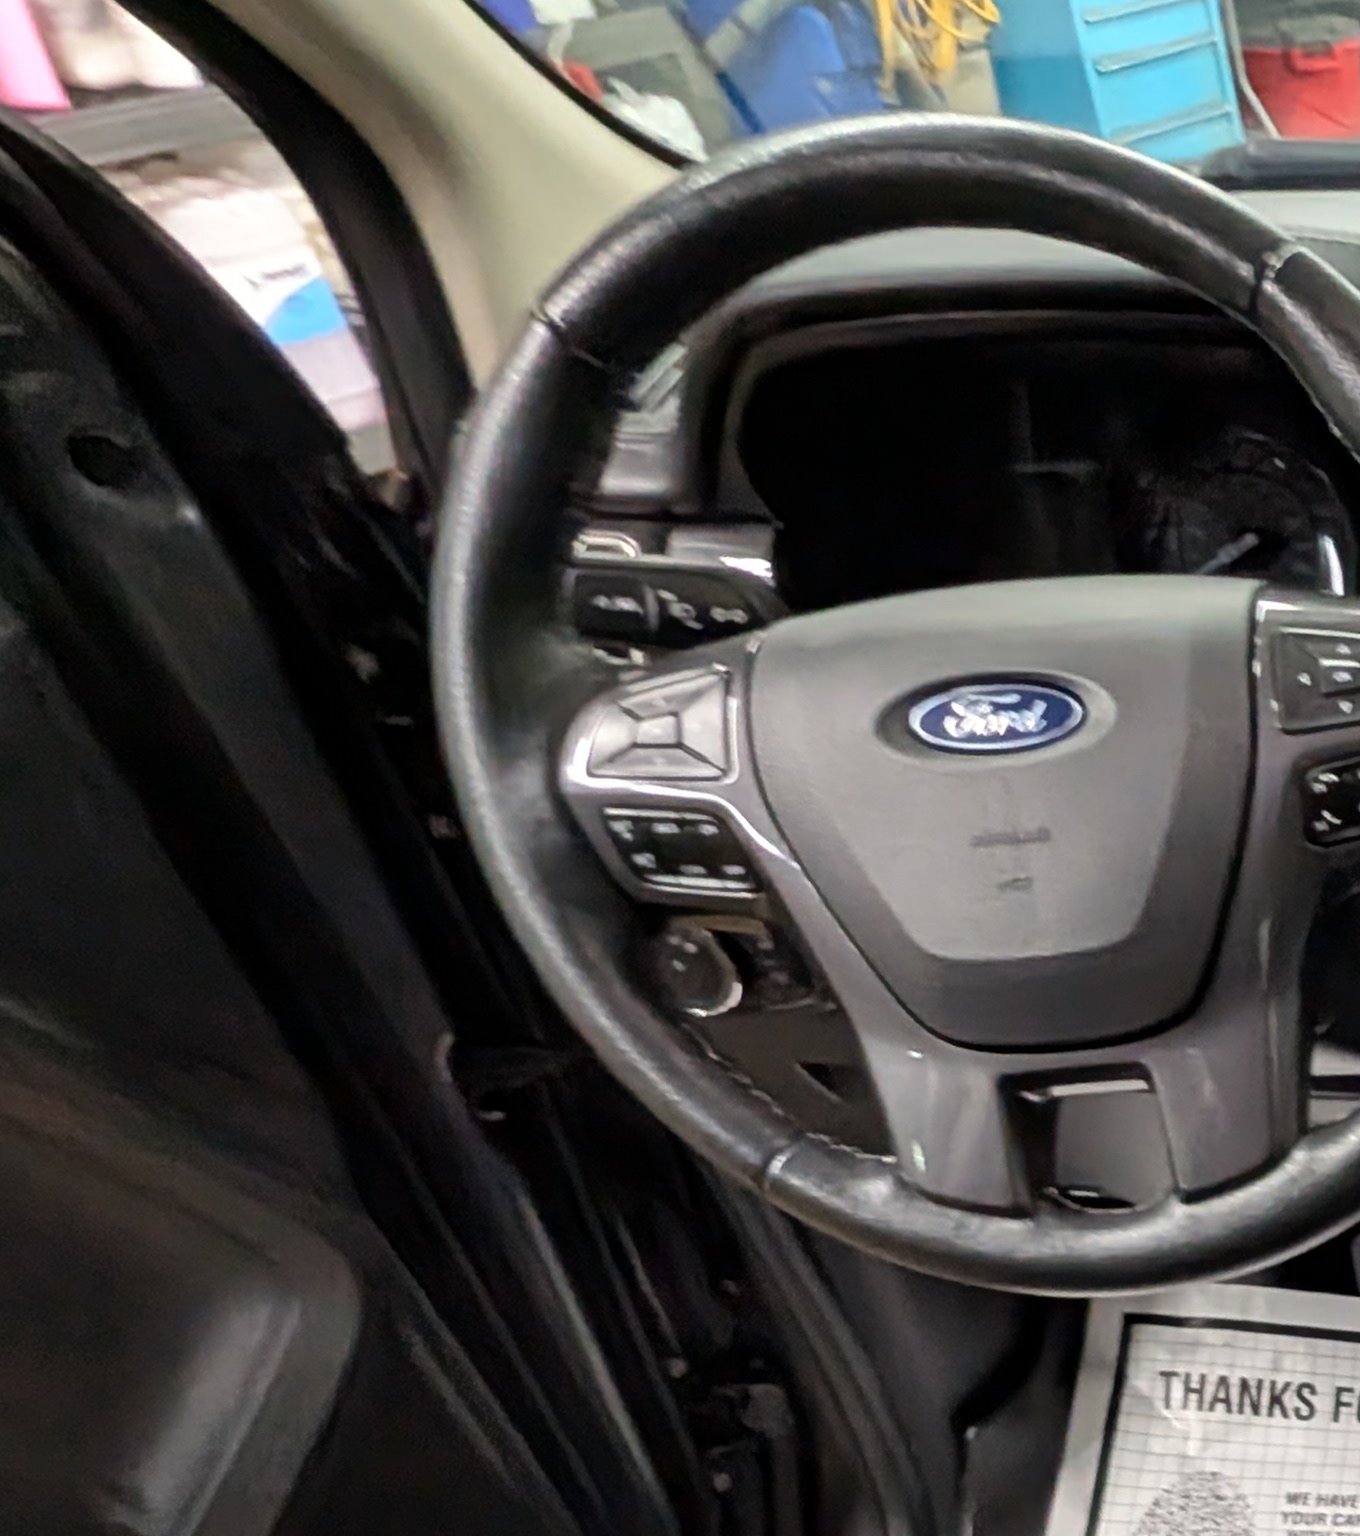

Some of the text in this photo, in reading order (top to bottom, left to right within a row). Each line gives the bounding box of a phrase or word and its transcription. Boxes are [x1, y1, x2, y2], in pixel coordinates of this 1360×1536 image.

[943, 693, 1048, 738] Ford
[1158, 1369, 1319, 1422] THANKS
[1286, 1491, 1312, 1507] WE
[1316, 1492, 1360, 1509] HAVE
[1281, 1511, 1328, 1527] YOUR
